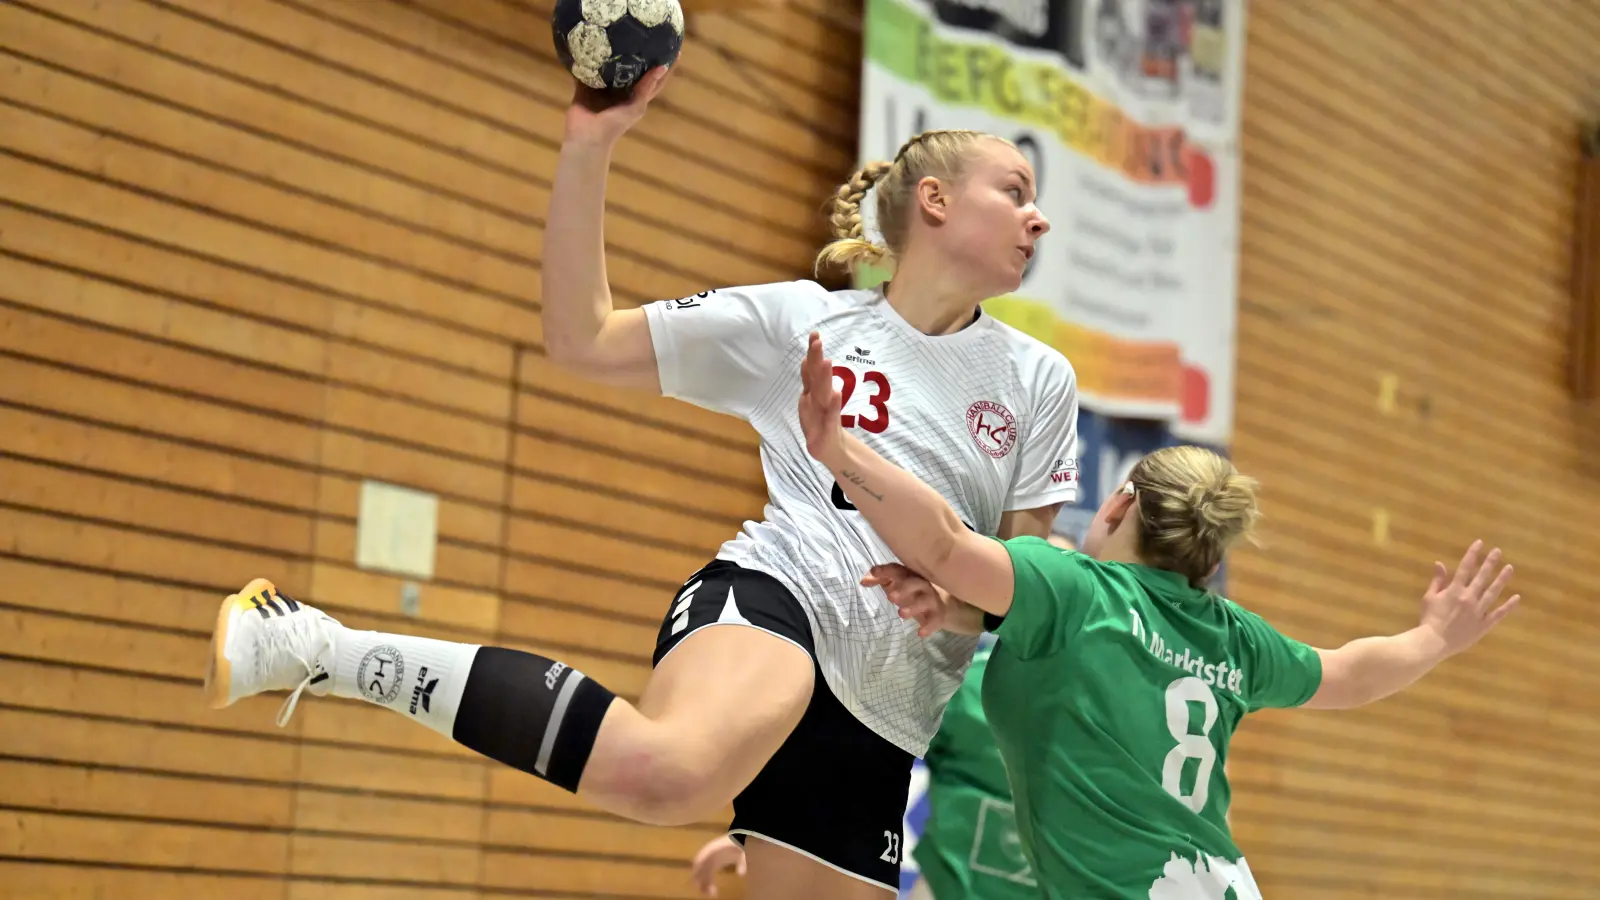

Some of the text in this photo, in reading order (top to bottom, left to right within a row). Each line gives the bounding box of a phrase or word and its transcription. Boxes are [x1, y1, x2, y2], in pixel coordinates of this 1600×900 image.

[845, 354, 876, 366] erima
[832, 366, 891, 434] 23
[1050, 471, 1072, 483] WE
[409, 666, 429, 715] erima
[1161, 676, 1219, 815] 8
[879, 829, 900, 865] 23
